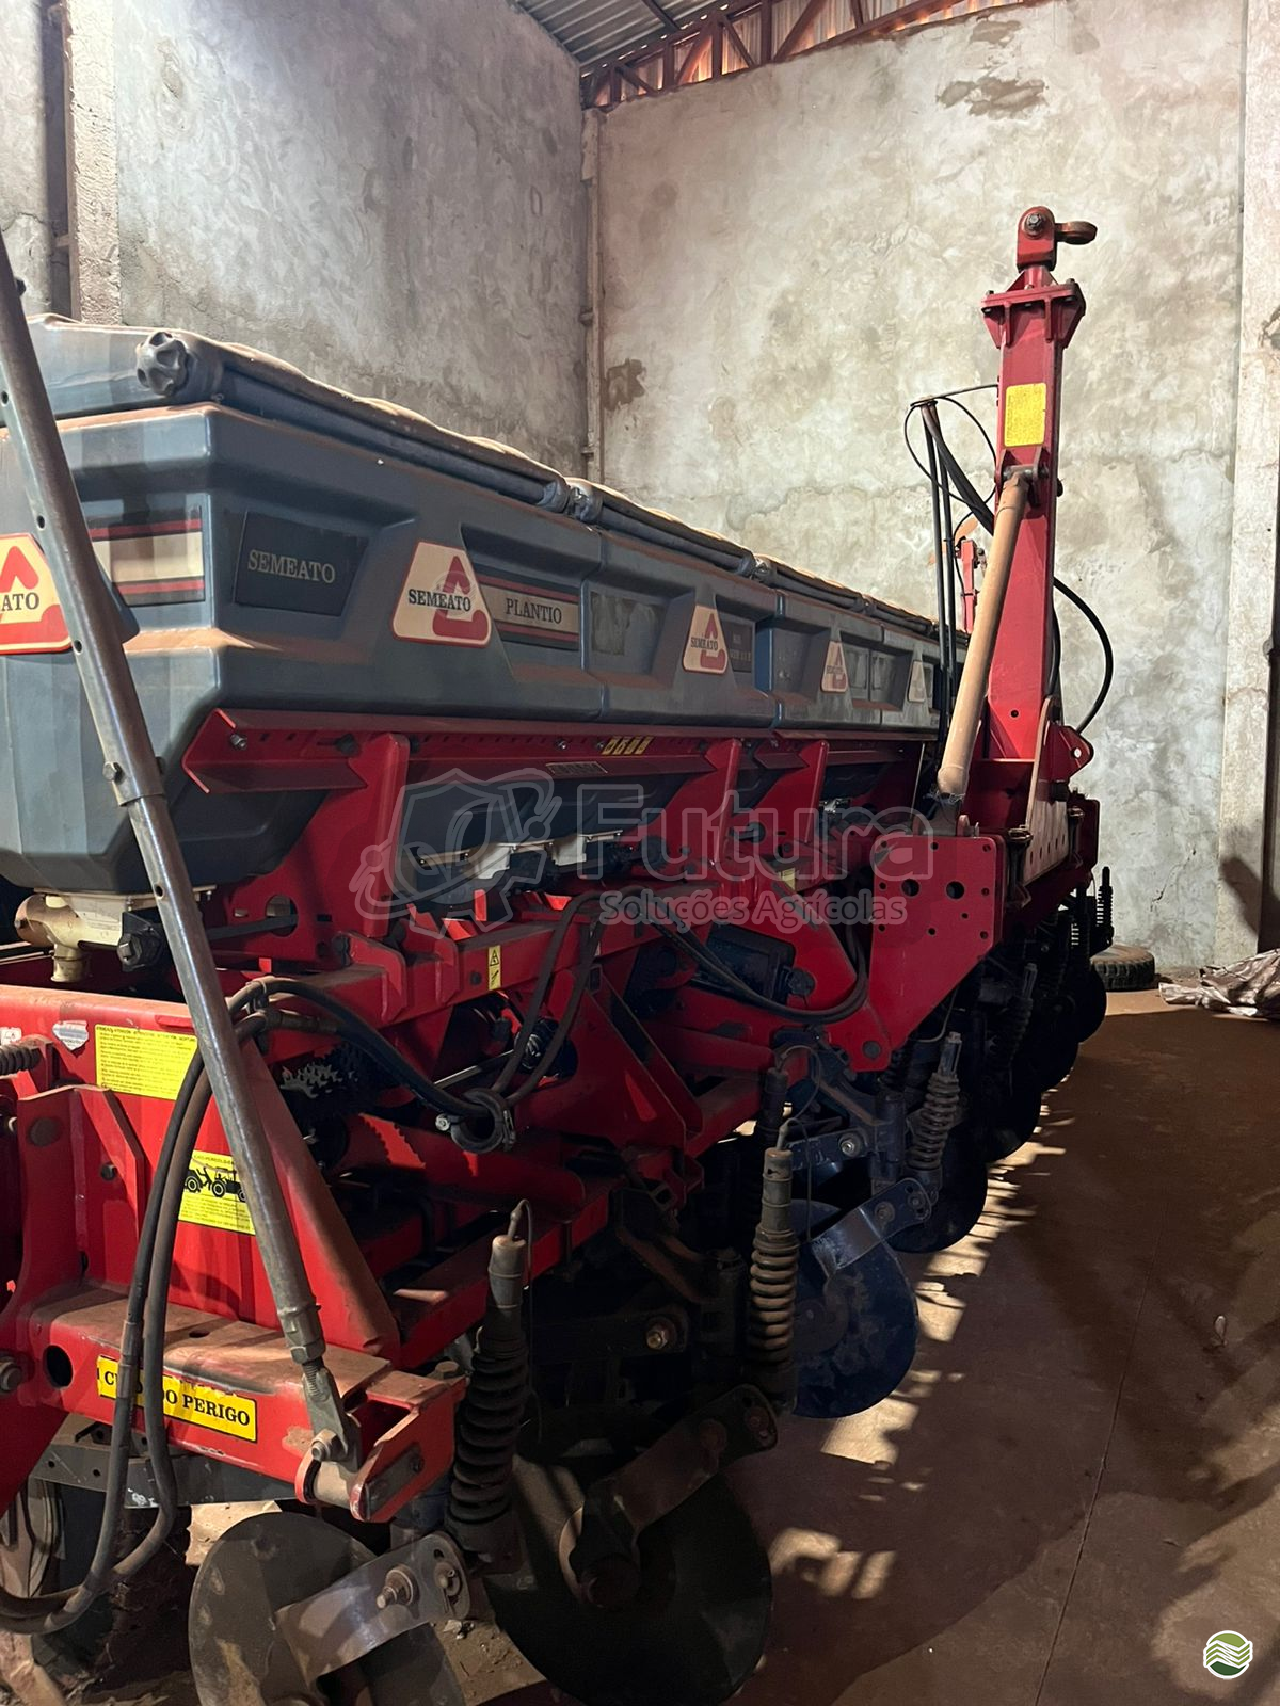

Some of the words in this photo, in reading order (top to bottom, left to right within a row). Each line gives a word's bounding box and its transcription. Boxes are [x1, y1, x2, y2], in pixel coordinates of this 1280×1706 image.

[247, 549, 335, 583] SEMEATO
[409, 589, 471, 612] SEMEATO
[506, 597, 562, 624] PLANTIO
[182, 1393, 250, 1427] PERIGO
